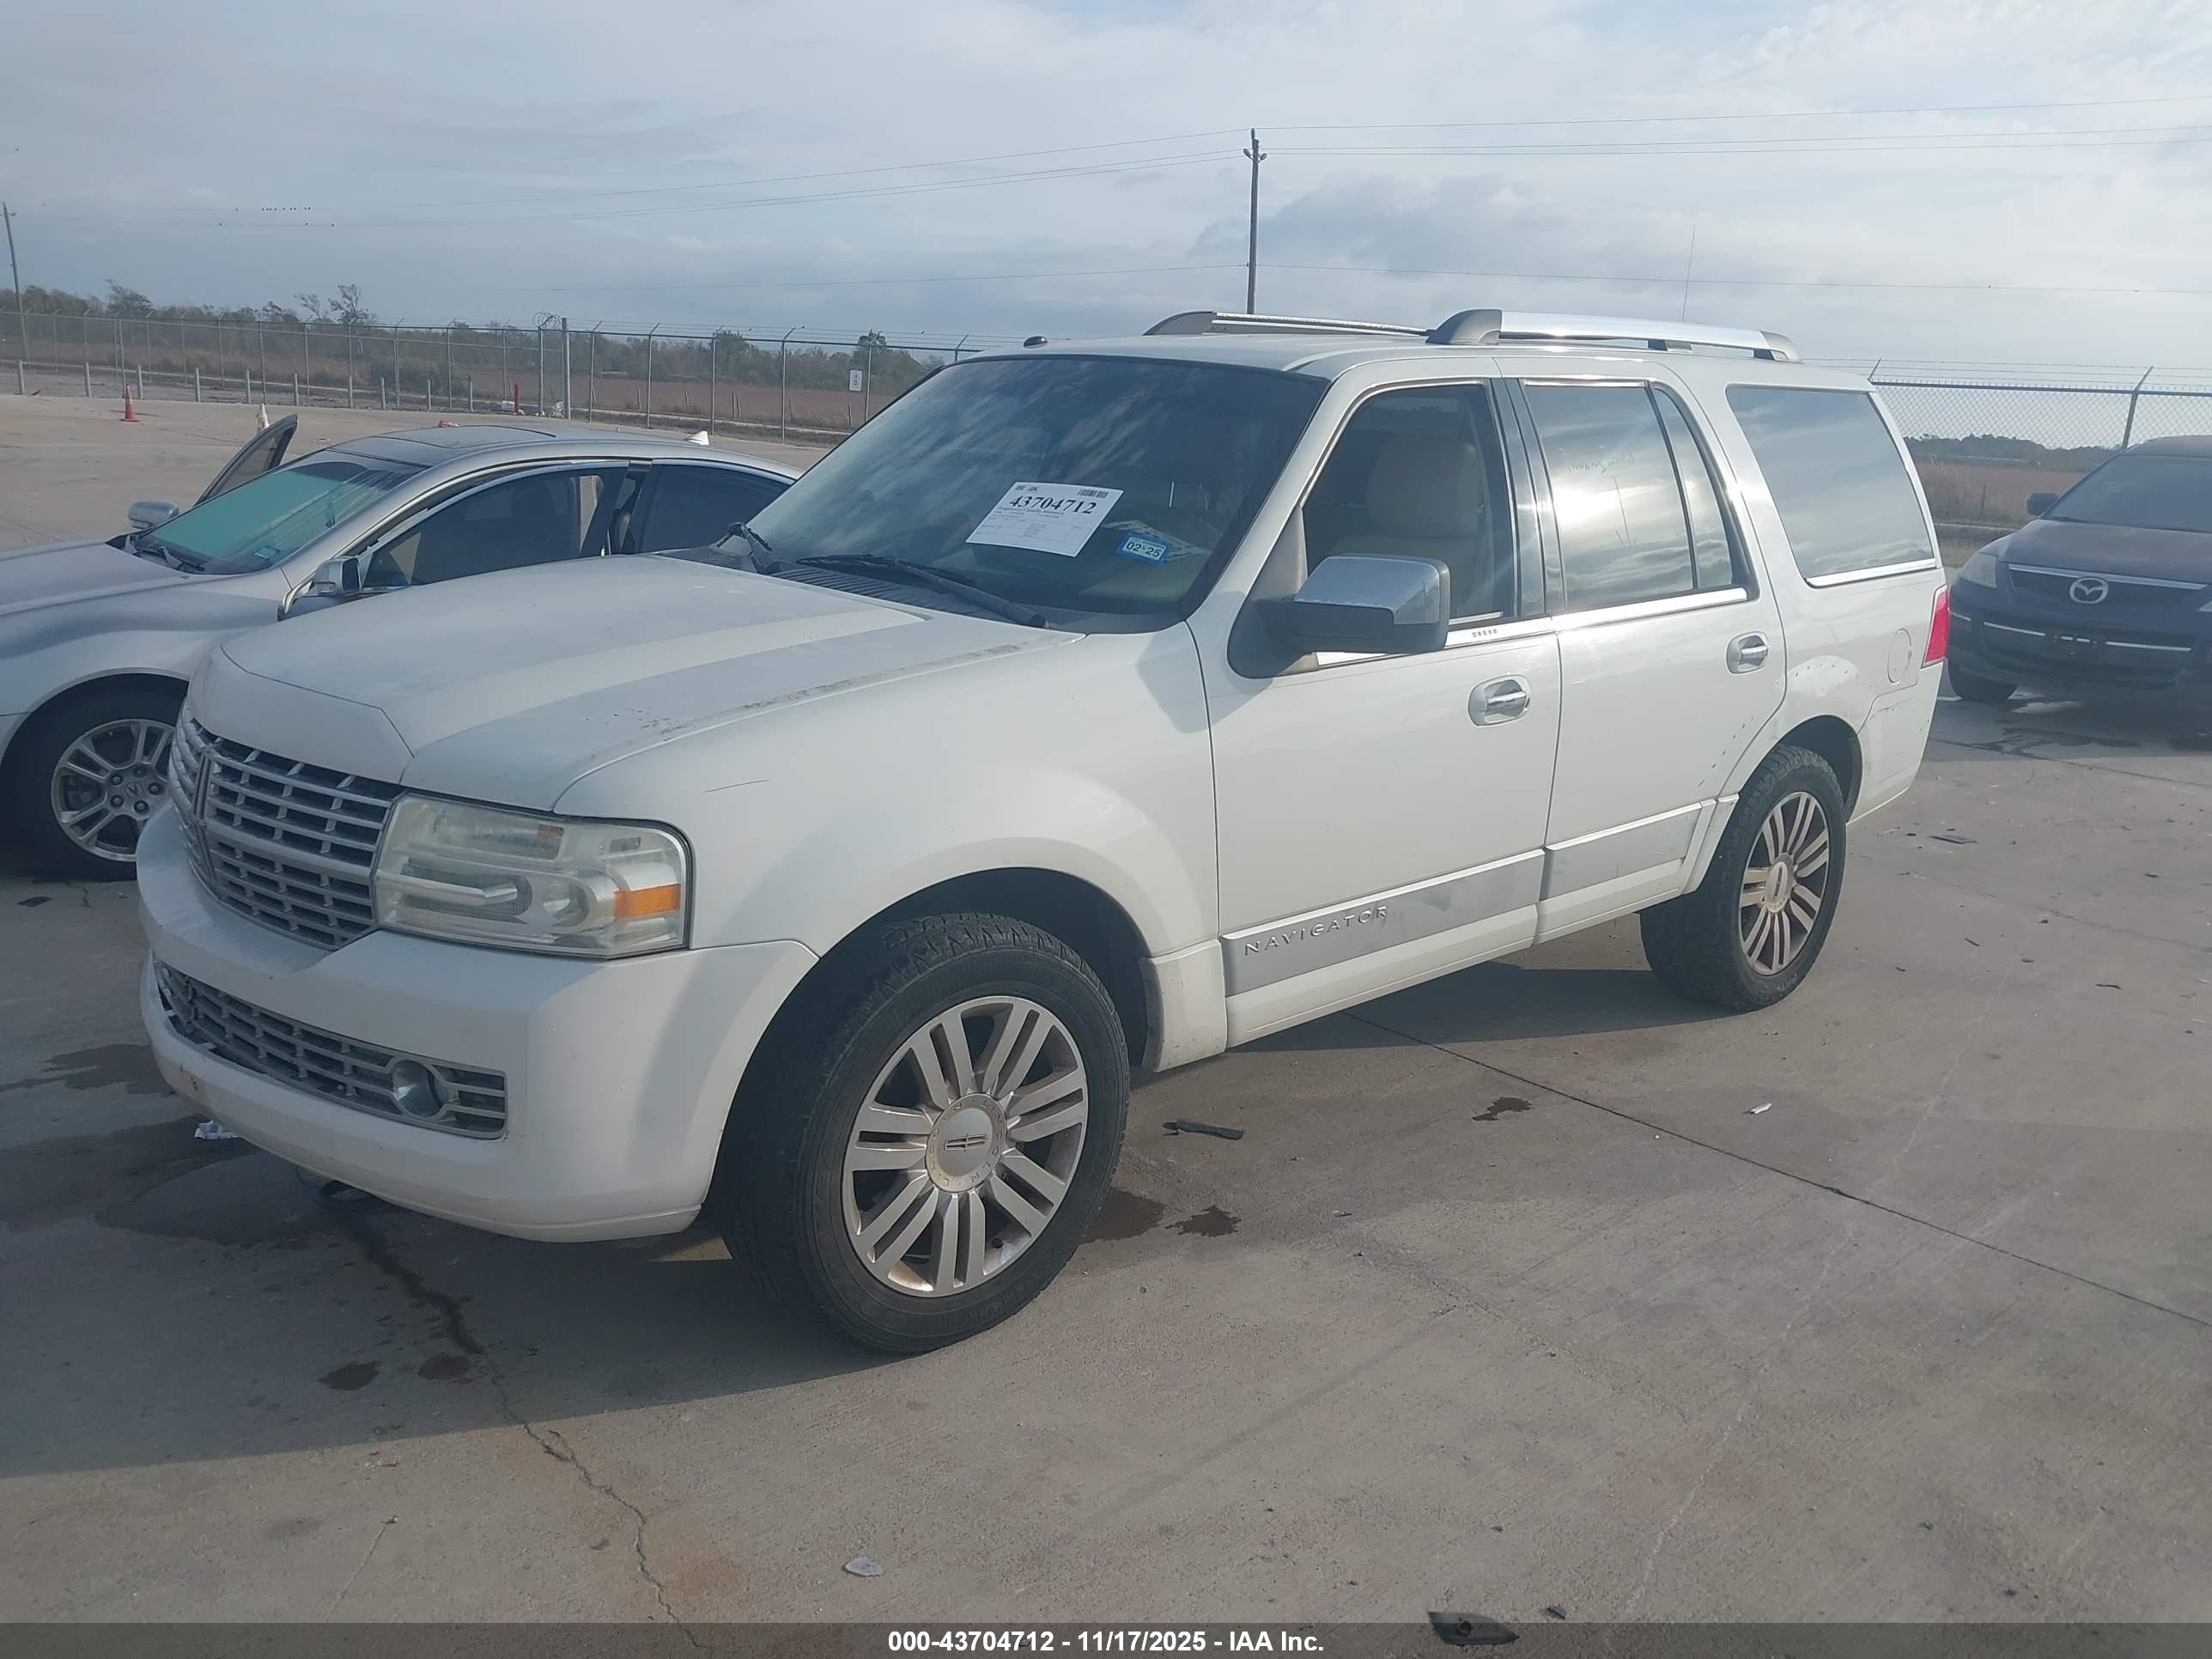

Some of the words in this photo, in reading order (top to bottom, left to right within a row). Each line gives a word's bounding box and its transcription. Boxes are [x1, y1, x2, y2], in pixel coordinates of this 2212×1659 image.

[1009, 495, 1097, 514] 43704712
[1126, 542, 1142, 552] 02
[1146, 547, 1163, 557] 25
[1245, 906, 1388, 956] NAVIGATOR
